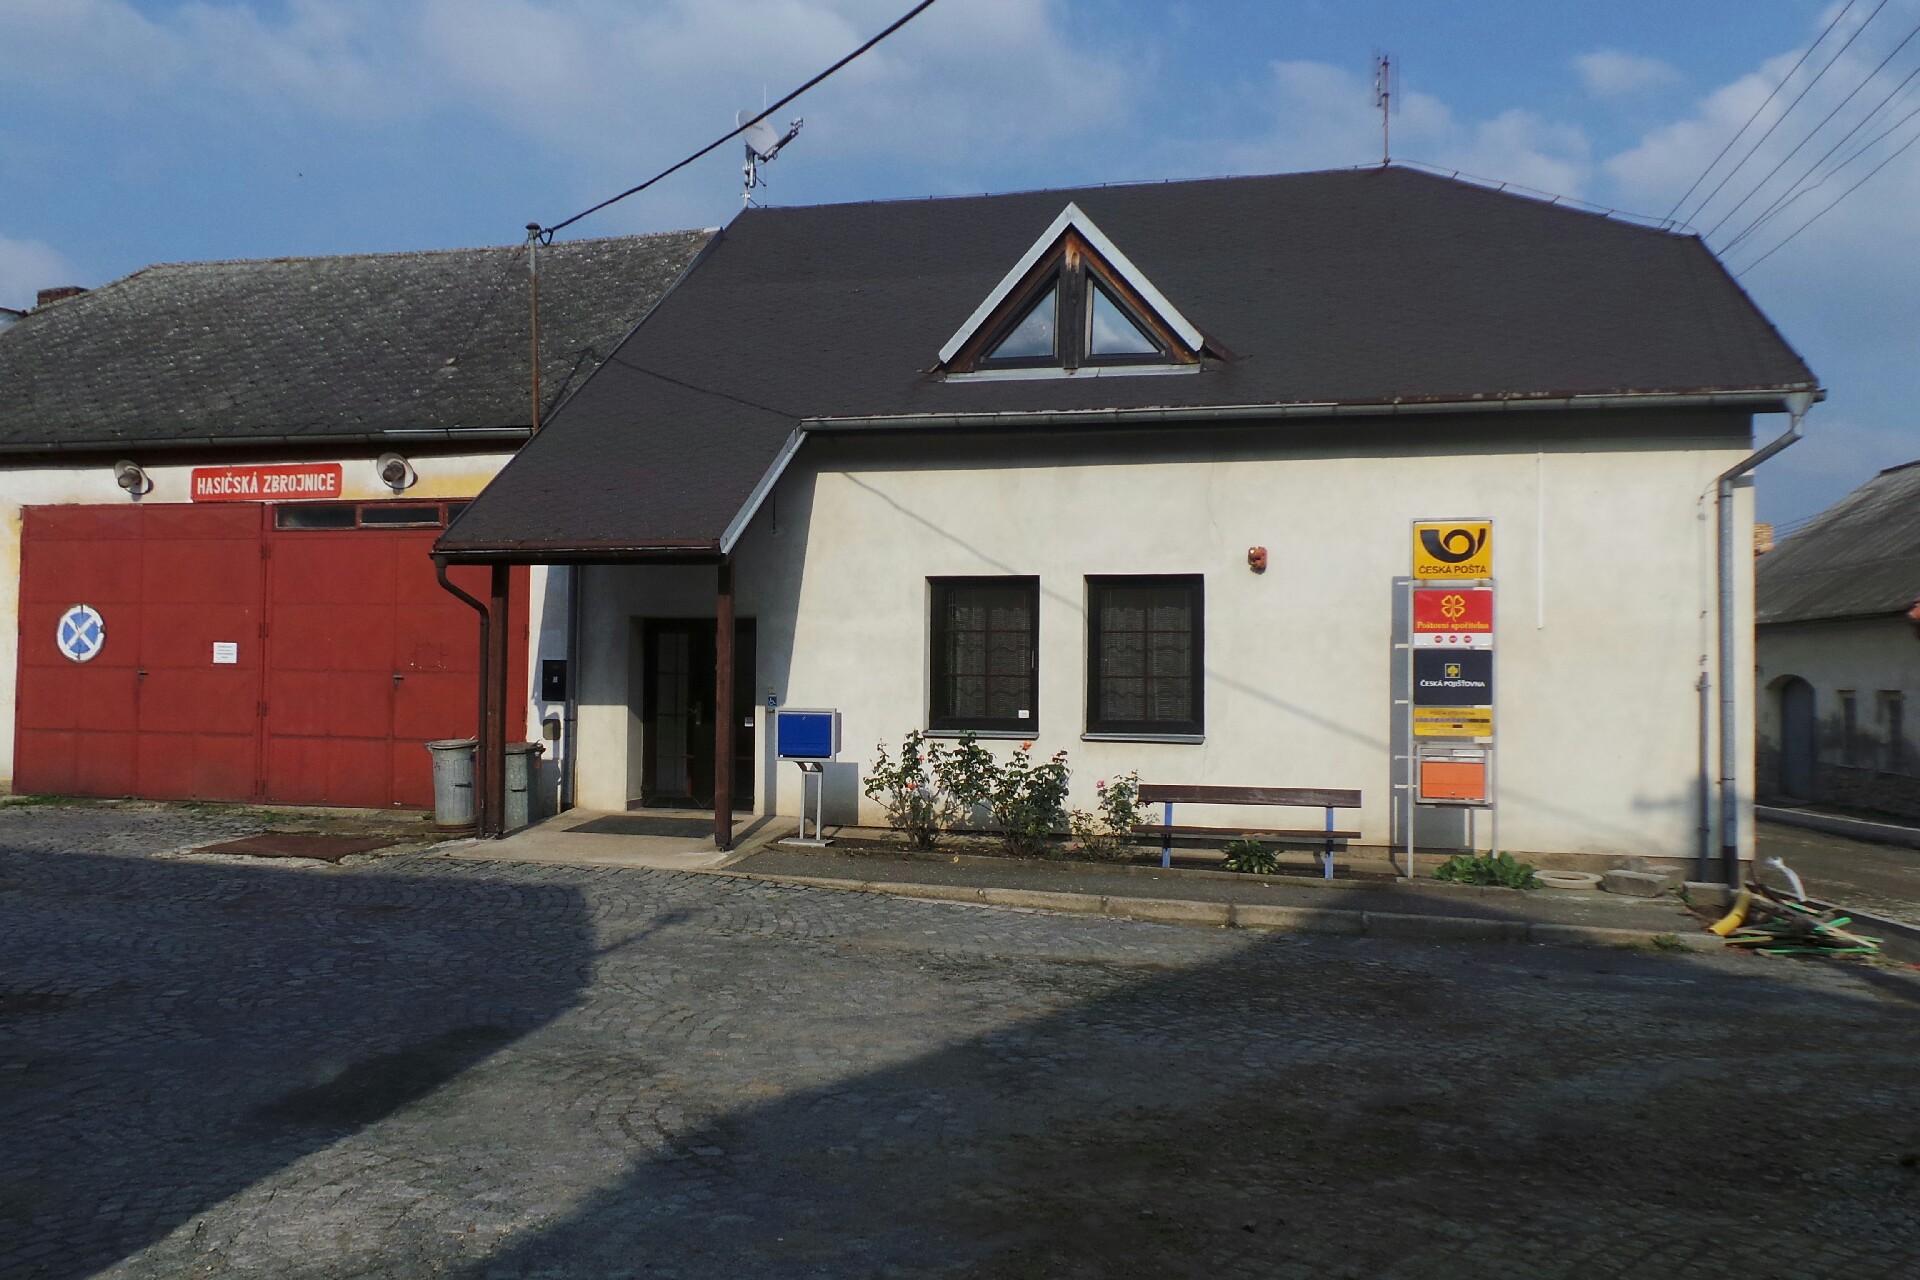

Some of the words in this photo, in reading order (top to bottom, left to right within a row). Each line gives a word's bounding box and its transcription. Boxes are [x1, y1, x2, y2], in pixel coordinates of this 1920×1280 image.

[197, 472, 258, 494] HASIČSKÁ
[263, 473, 335, 493] ZBROJNICE
[1419, 564, 1452, 574] ČESKÁ
[1454, 564, 1487, 574] POŠTA
[1417, 621, 1449, 629] Poštovní
